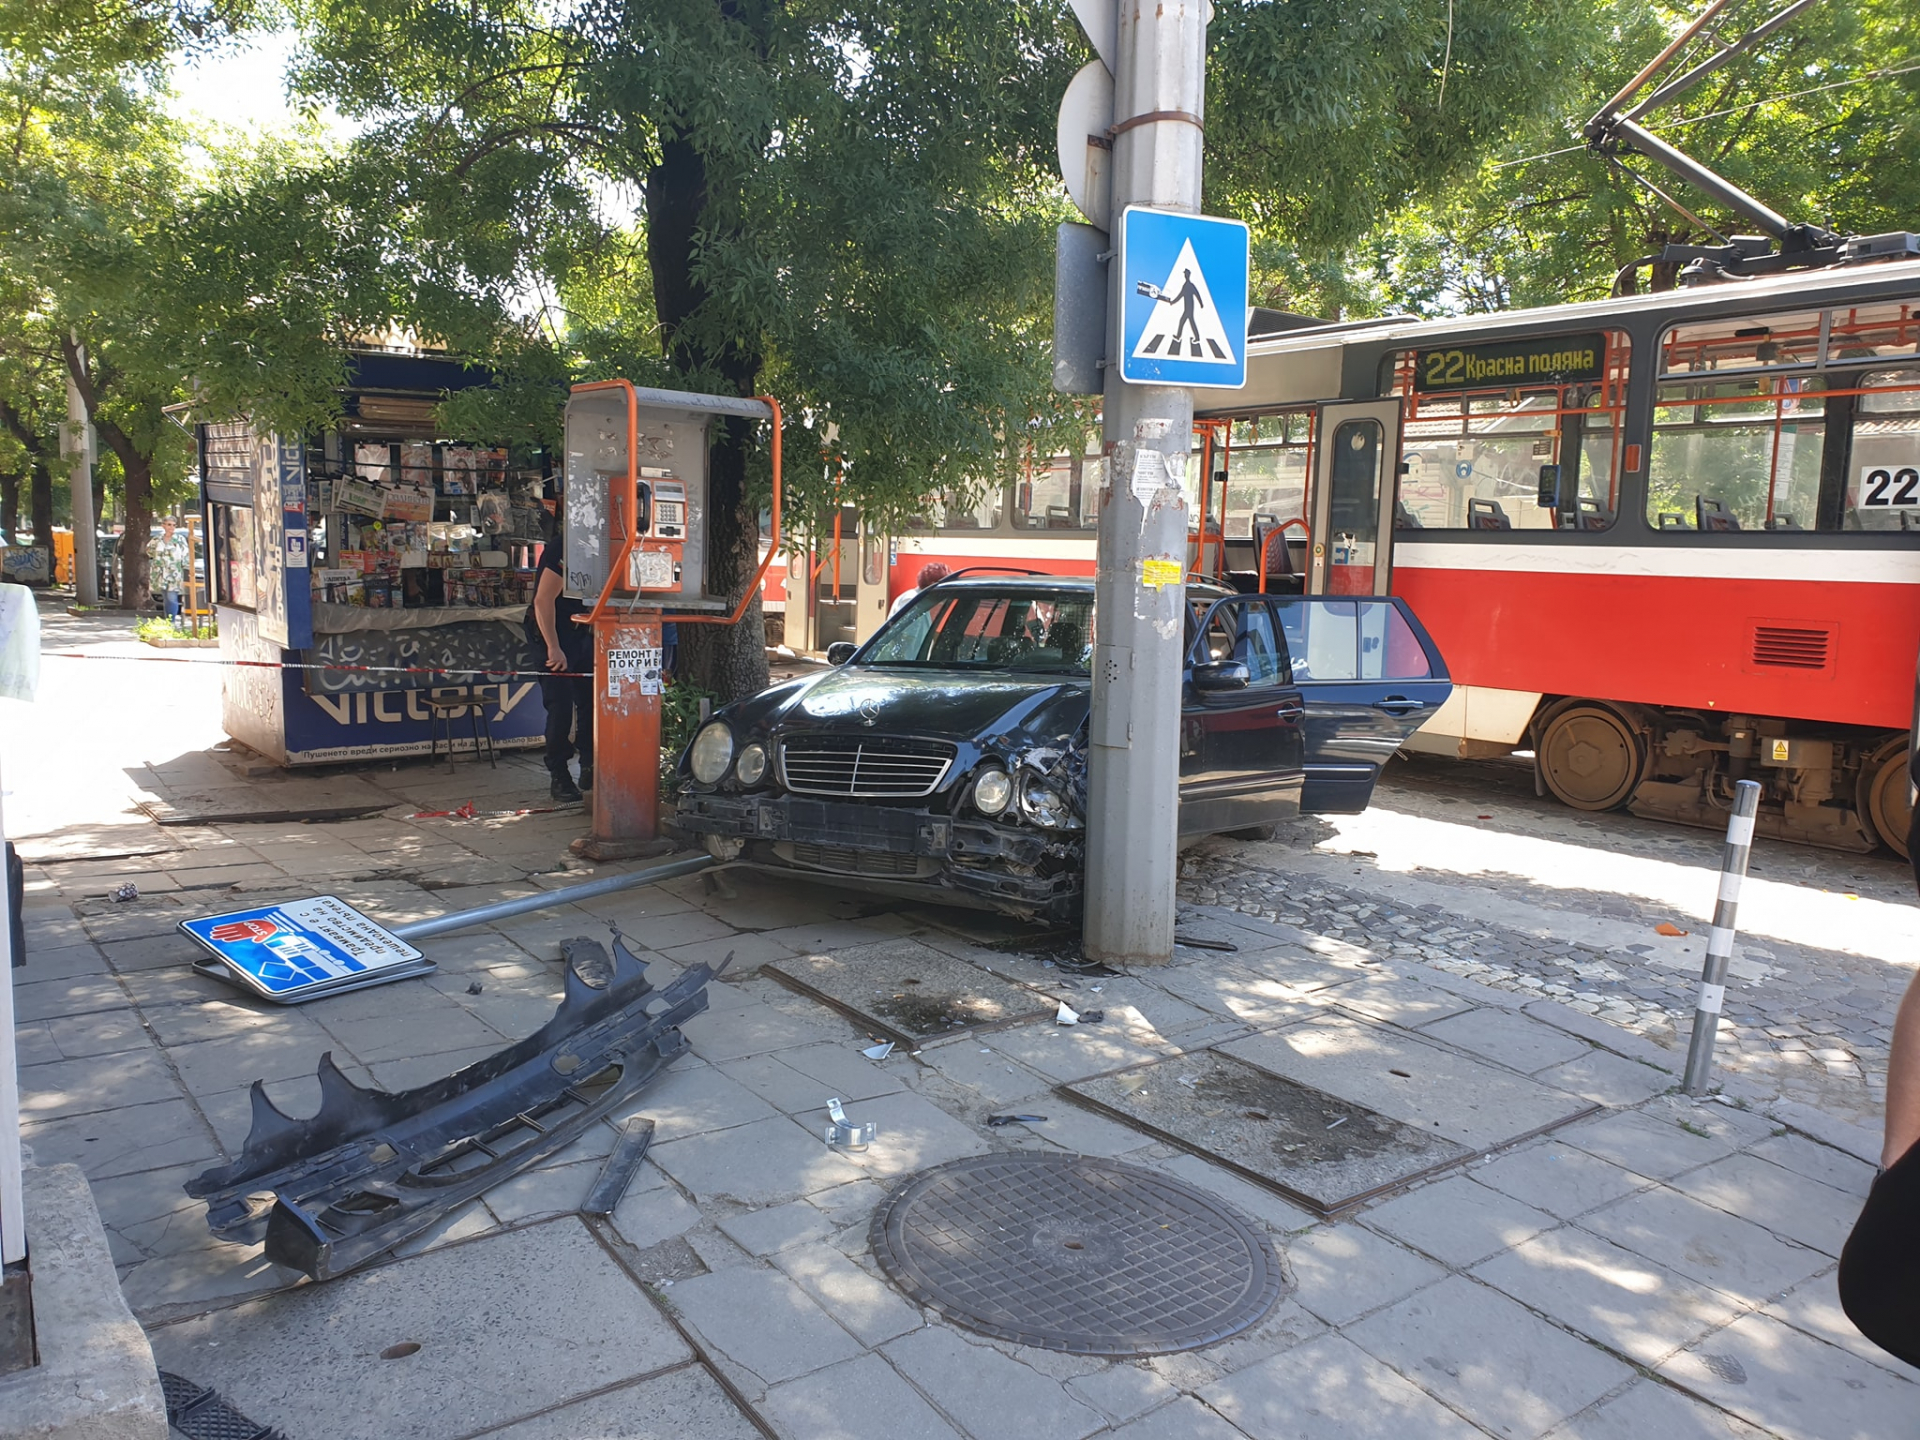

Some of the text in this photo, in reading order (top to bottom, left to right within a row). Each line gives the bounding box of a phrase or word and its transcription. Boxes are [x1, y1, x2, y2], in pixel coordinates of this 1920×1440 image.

[1426, 350, 1594, 385] 22 Красна поляна
[1865, 468, 1919, 505] 22
[608, 650, 652, 659] РЕМОНТ
[303, 749, 348, 760] Пушенето
[350, 748, 377, 757] вреди
[379, 744, 420, 754] сериозно
[243, 921, 268, 936] STOP
[312, 906, 387, 955] предимство на
[317, 925, 366, 957] Трамваят
[355, 921, 412, 958] пешеходна
